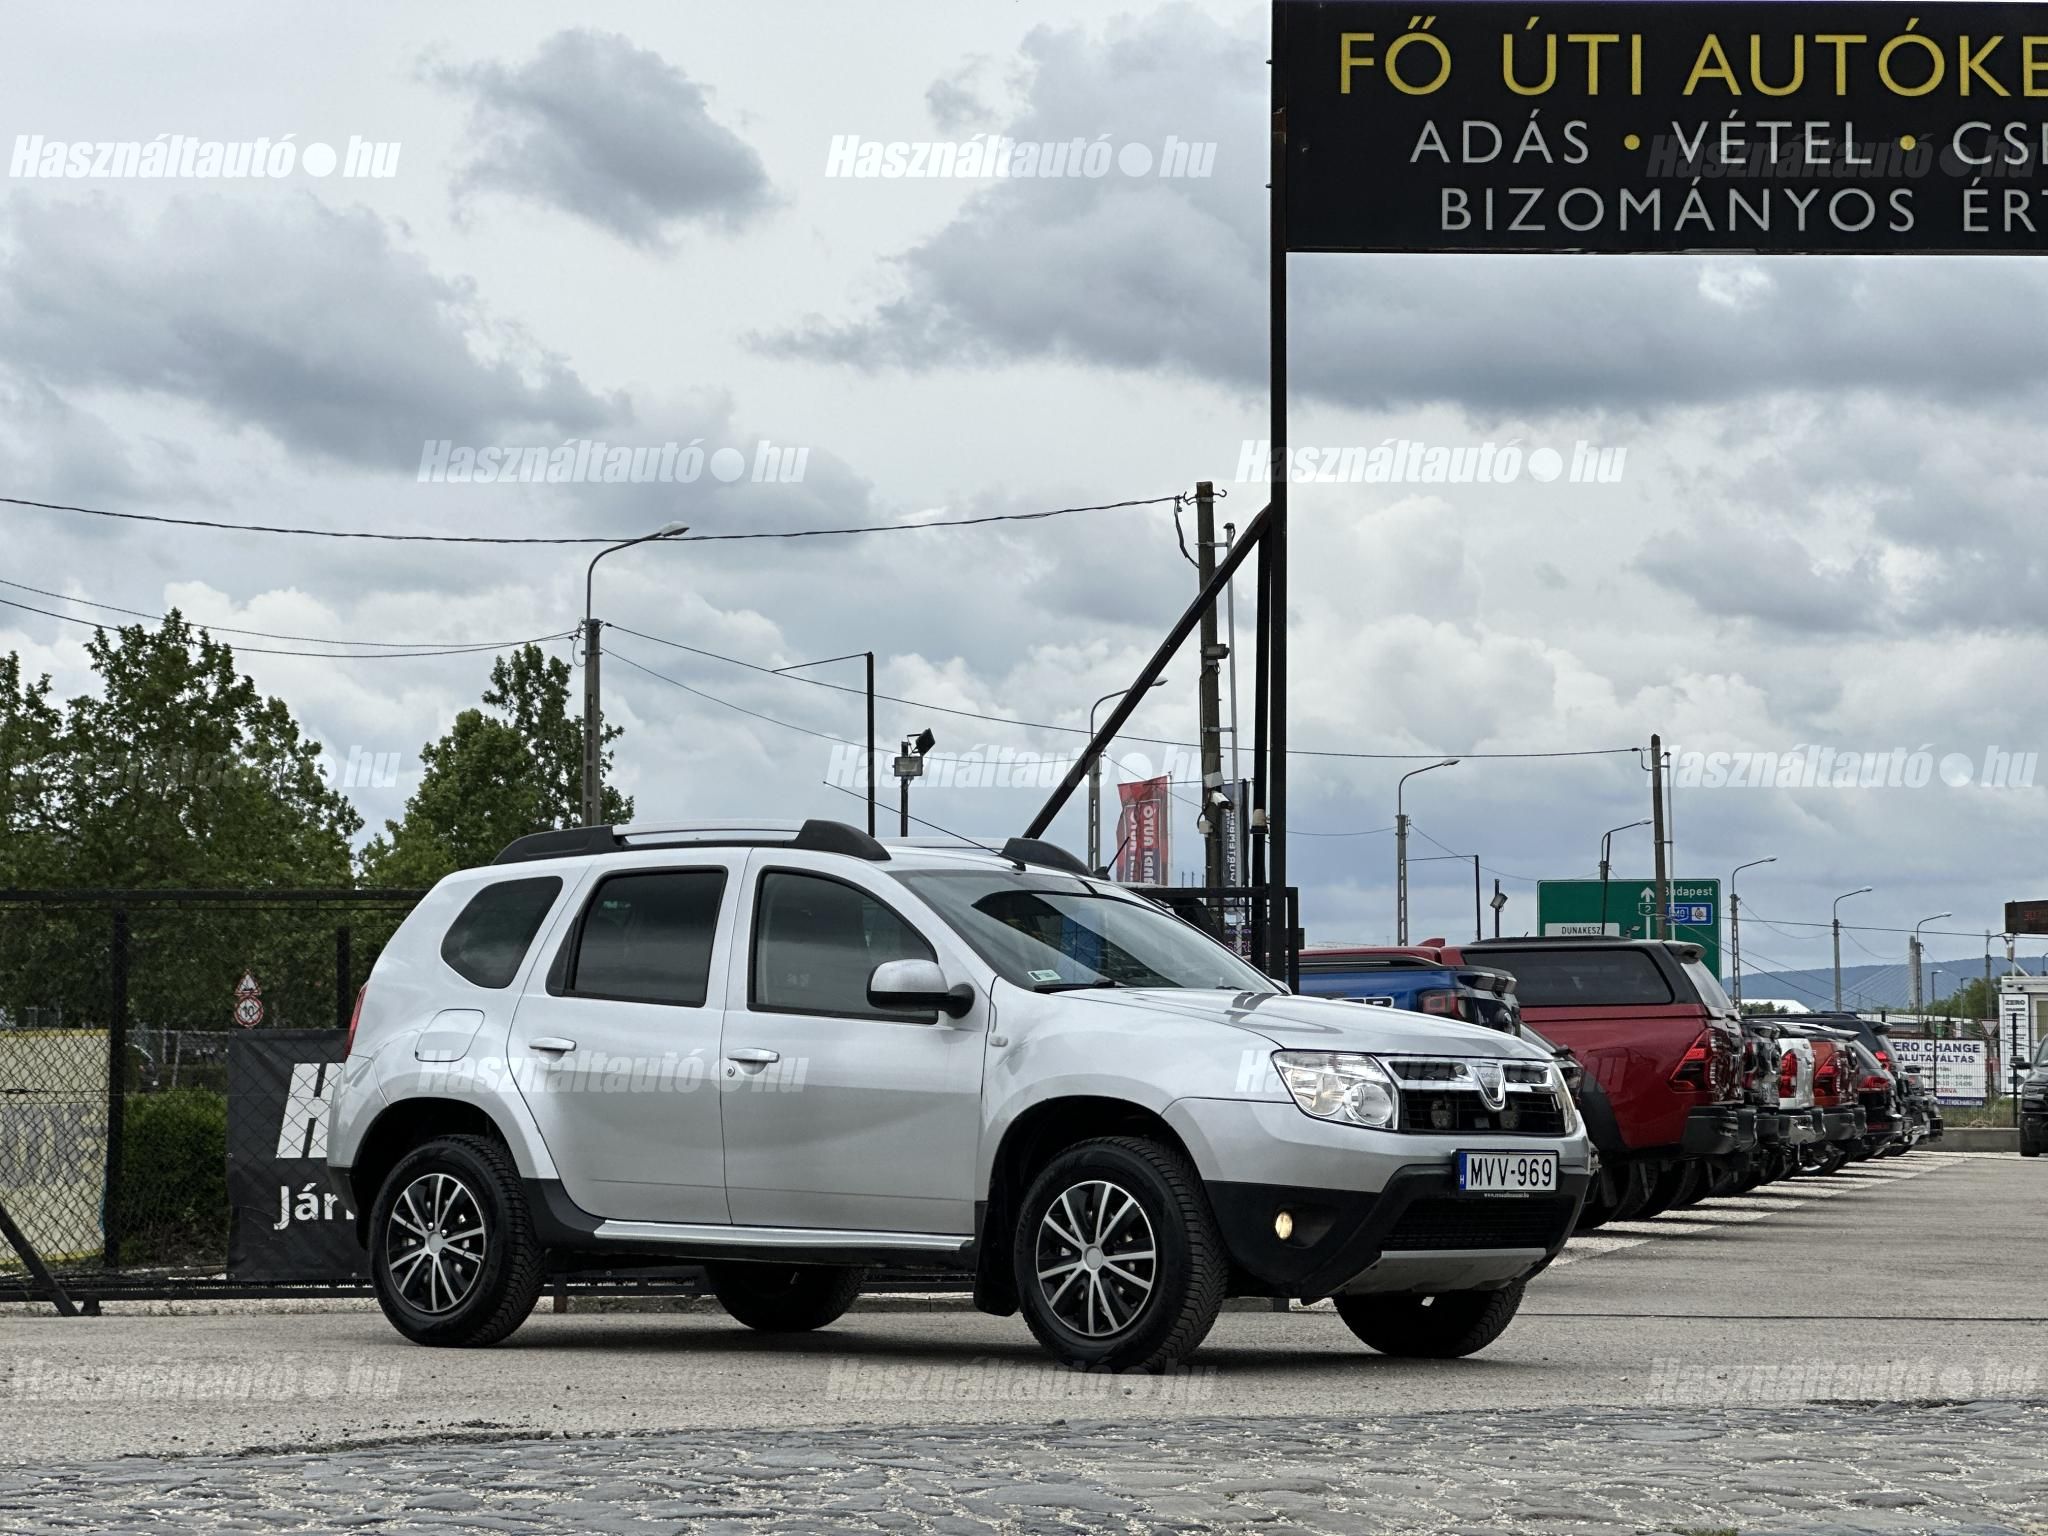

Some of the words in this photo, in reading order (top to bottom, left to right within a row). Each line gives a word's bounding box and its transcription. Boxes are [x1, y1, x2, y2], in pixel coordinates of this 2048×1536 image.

[1340, 16, 1452, 97] FŐ
[1503, 17, 1643, 96] ÚTI
[1683, 17, 2048, 97] AUTÓKE
[1409, 110, 1590, 165] ADÁS
[1671, 109, 1873, 165] VÉTEL
[1952, 120, 2048, 165] CS
[1440, 178, 1916, 233] BIZOMÁNYOS
[1963, 177, 2048, 233] ÉR
[1644, 905, 1651, 913] 2
[1893, 1042, 1920, 1052] ERO
[1924, 1043, 1981, 1053] CHANGE
[1471, 1157, 1552, 1187] MVV-969
